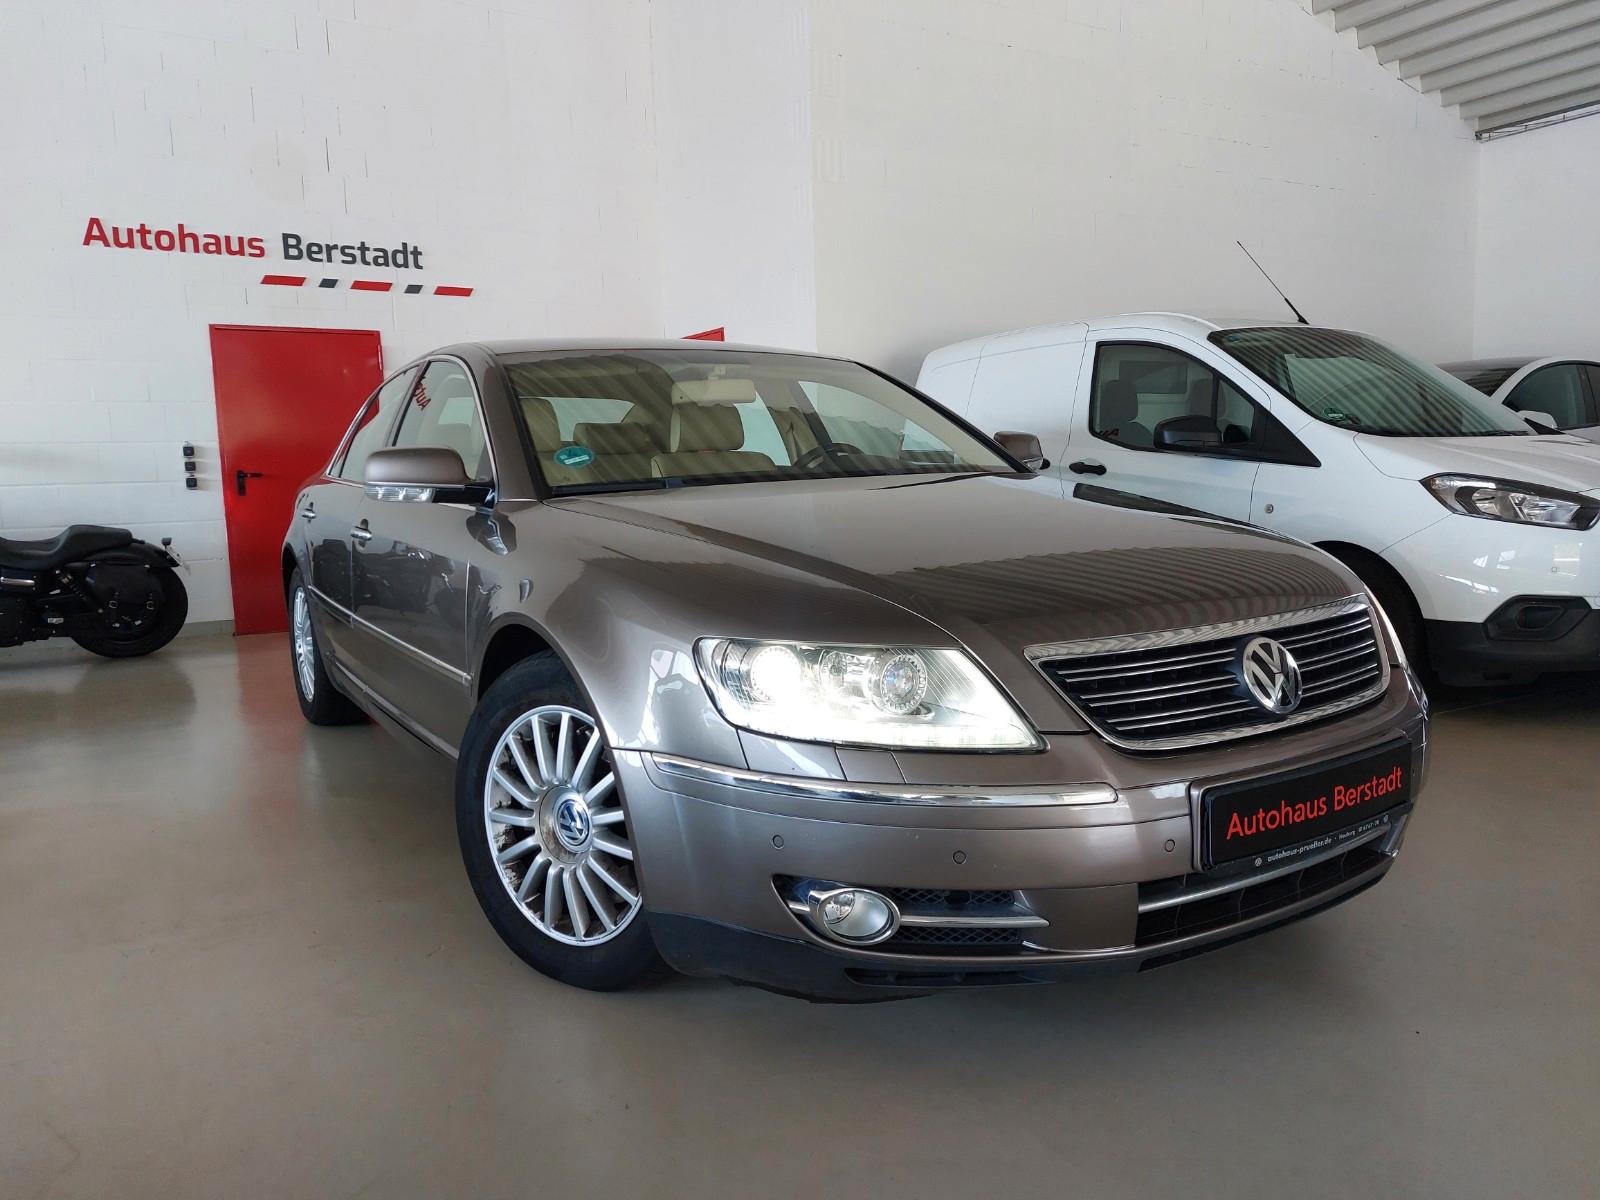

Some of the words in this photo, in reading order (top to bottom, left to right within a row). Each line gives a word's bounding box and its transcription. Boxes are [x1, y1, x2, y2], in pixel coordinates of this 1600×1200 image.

[83, 217, 265, 257] Autohaus
[282, 233, 423, 270] Berstadt
[1227, 795, 1326, 839] Autohaus
[1334, 767, 1402, 810] Berstadt
